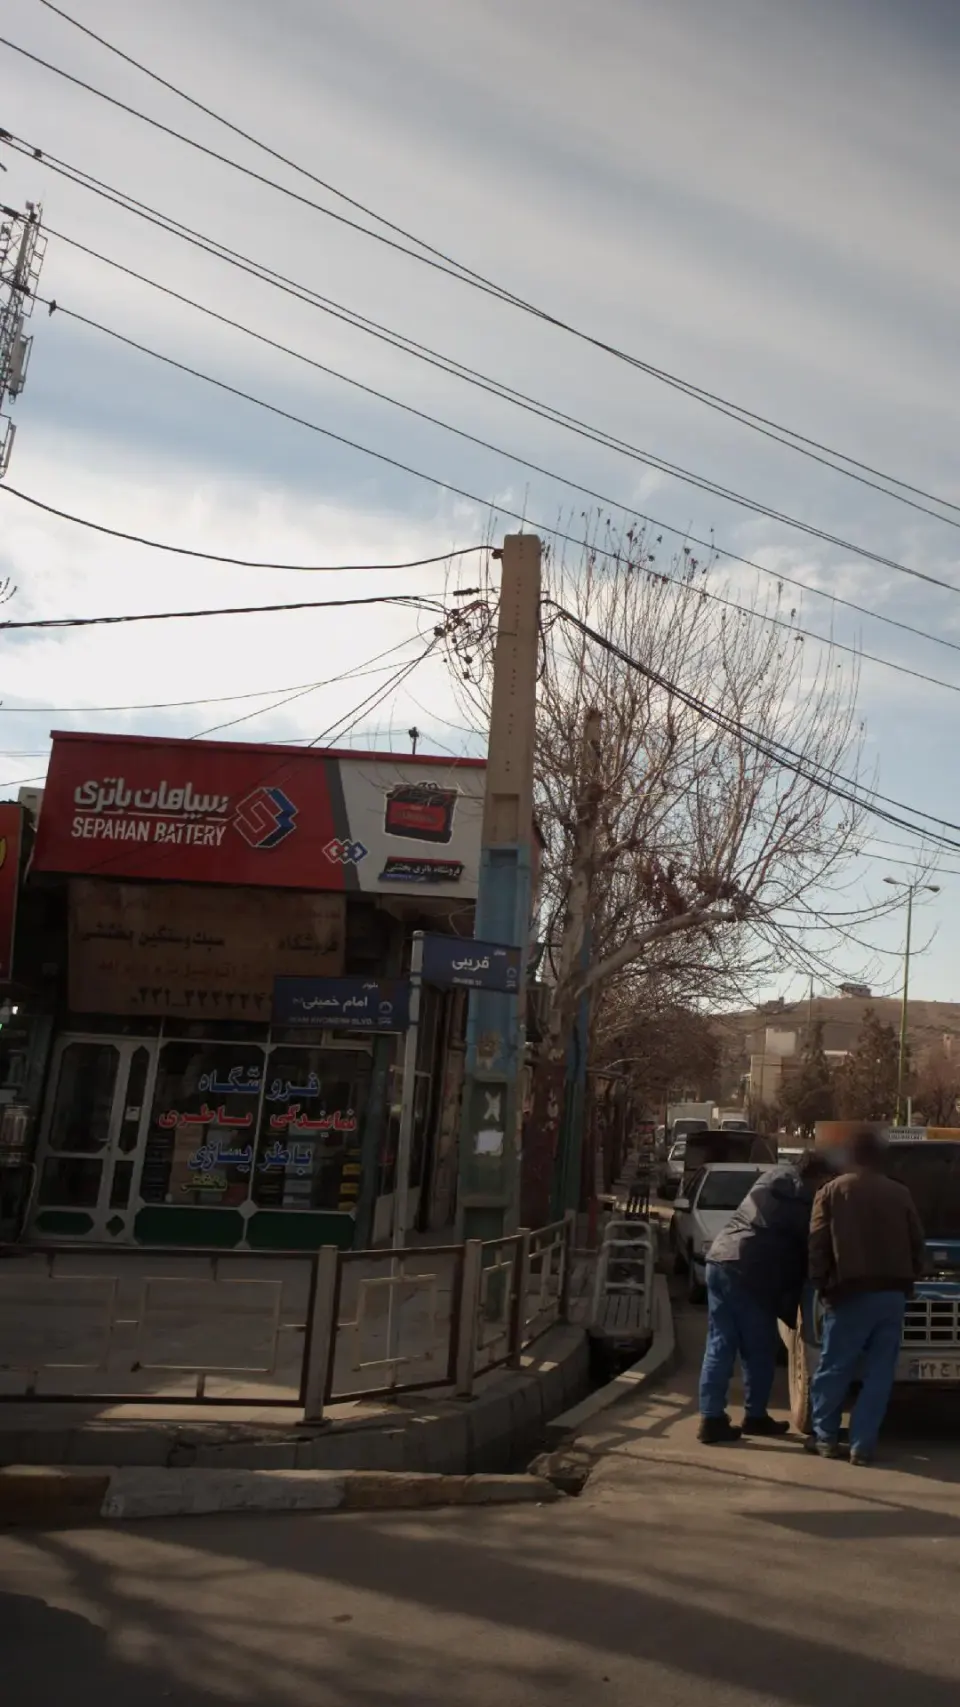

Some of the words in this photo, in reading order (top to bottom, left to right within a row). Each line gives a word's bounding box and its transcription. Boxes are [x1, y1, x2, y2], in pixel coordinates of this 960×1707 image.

[73, 777, 131, 814] باتری
[135, 781, 229, 819] سپاهان
[71, 816, 151, 843] SEPAHAN
[154, 821, 226, 846] BATTERY
[302, 996, 340, 1010] خمینی
[342, 995, 368, 1013] امام
[198, 1066, 321, 1101] فروشگاه
[269, 1103, 357, 1138] نمایندگی
